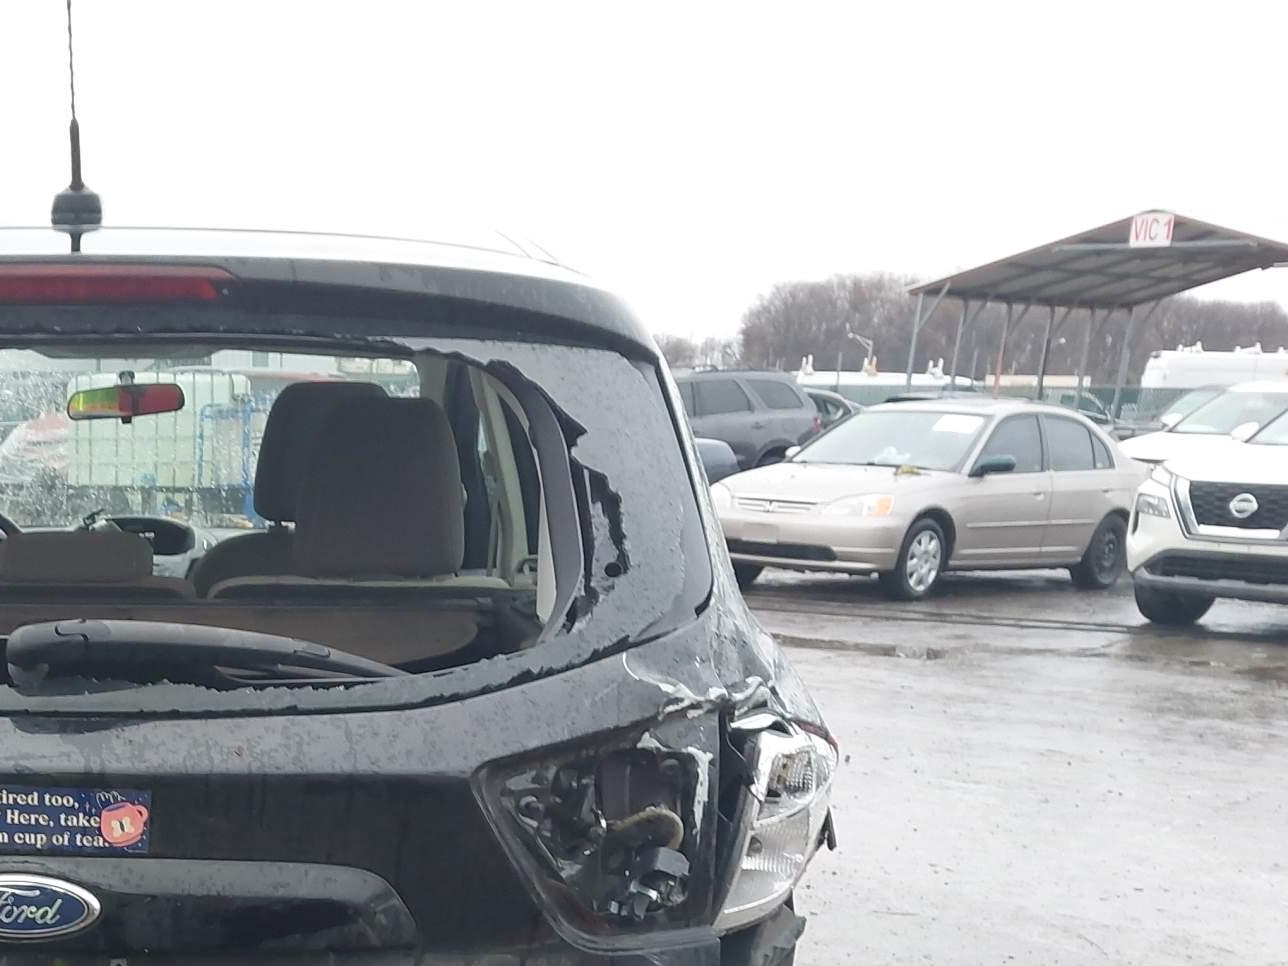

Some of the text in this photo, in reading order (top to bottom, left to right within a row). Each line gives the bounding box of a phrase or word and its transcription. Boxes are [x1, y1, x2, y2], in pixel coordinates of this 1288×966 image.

[1134, 217, 1172, 240] VIC 1
[44, 793, 79, 809] too,
[6, 812, 54, 826] Here,
[60, 813, 100, 828] take
[14, 833, 46, 848] cup
[52, 833, 70, 845] of
